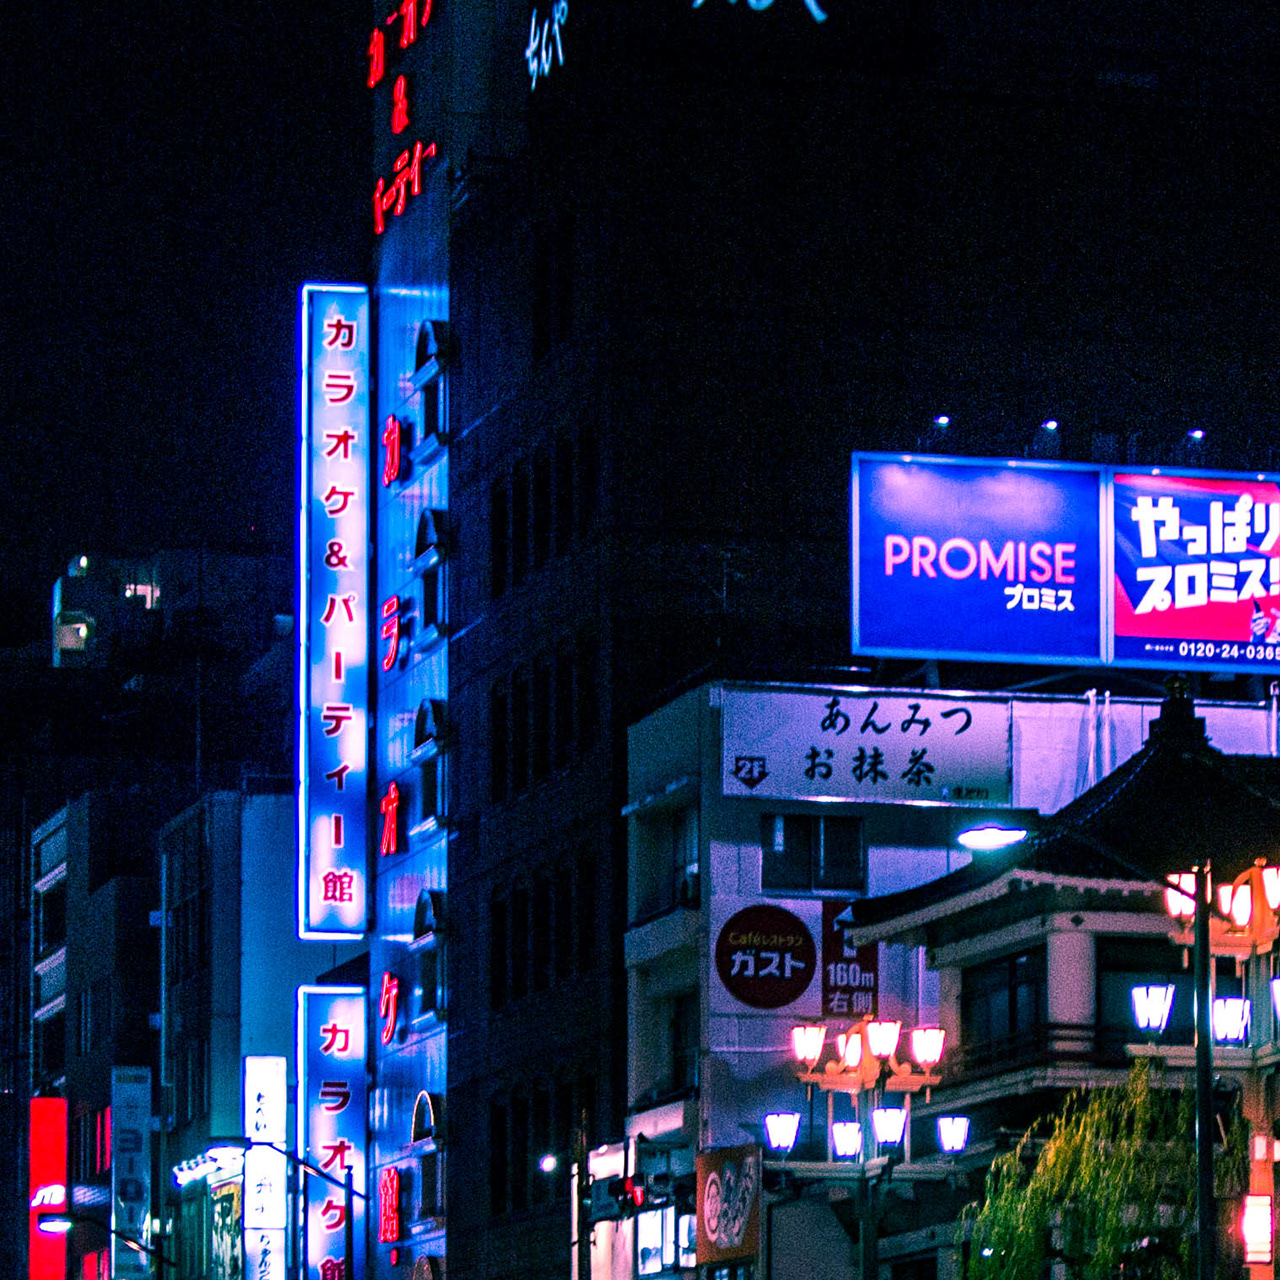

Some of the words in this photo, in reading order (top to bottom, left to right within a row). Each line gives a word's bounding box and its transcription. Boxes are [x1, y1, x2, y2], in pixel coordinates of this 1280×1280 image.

[1130, 493, 1280, 558] やっぱり
[884, 534, 1077, 585] PROMISE
[1003, 583, 1076, 612] プロミス
[1134, 557, 1280, 615] プロミス!
[321, 316, 357, 904] カラオケ&パーティー館
[820, 696, 973, 735] あんみつ
[804, 745, 936, 787] お抹茶
[730, 949, 806, 979] ガスト
[826, 962, 875, 987] 160m
